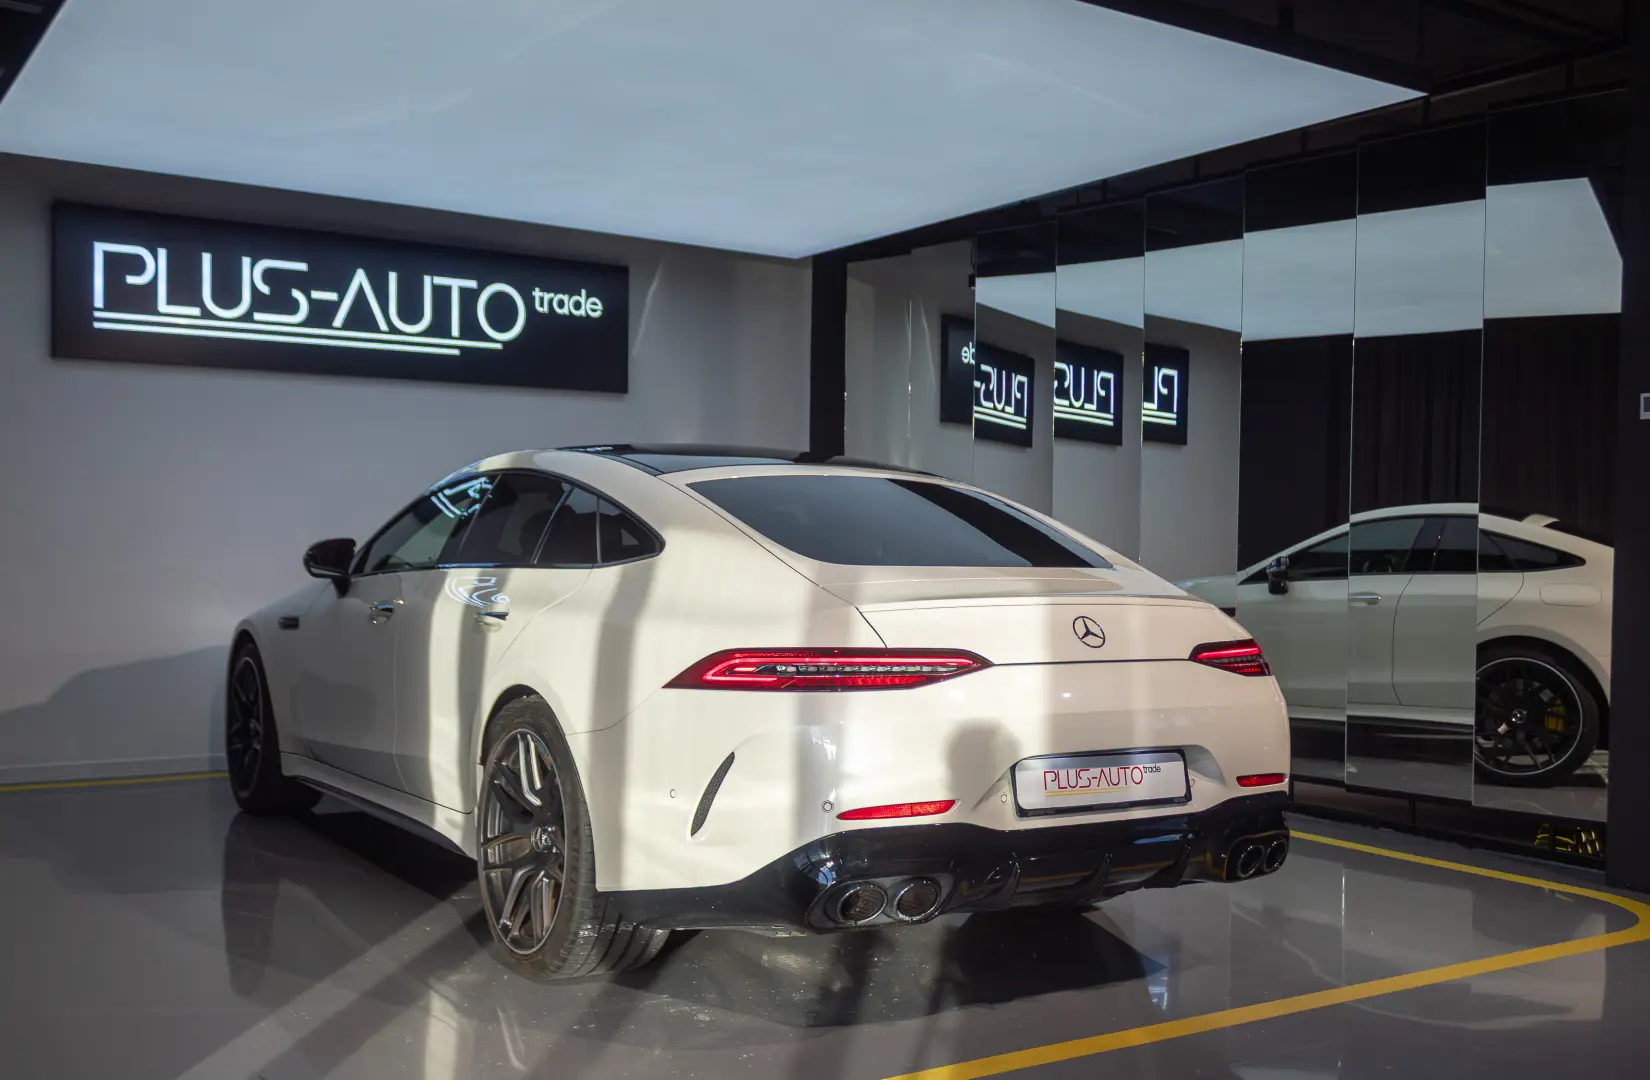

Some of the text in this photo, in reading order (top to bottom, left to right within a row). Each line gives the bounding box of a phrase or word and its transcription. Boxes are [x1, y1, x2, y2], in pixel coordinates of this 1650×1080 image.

[93, 241, 604, 342] PLUS-AUTO trade
[1043, 763, 1162, 791] PLUS-AUTO trade
